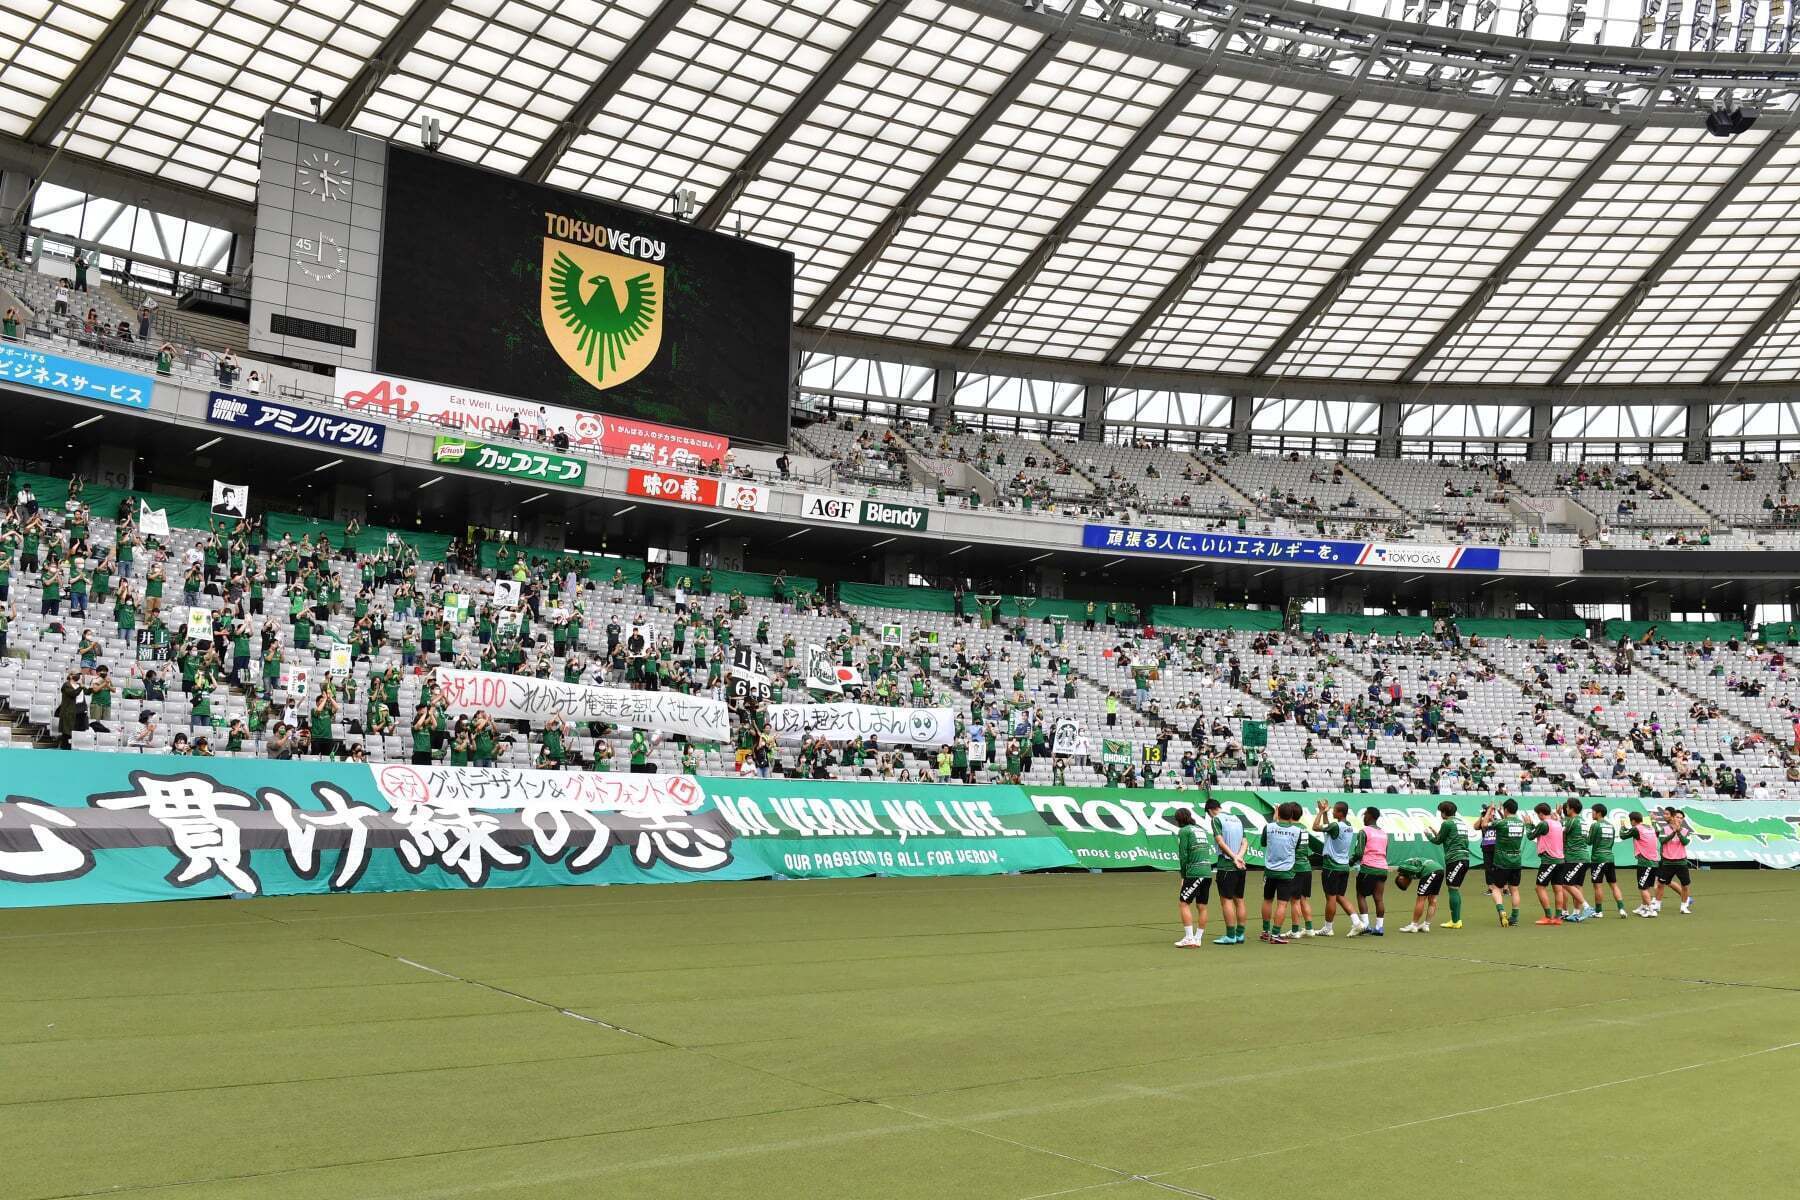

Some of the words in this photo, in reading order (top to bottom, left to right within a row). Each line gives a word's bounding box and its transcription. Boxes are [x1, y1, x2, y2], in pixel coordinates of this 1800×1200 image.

[544, 212, 607, 248] TOKYO
[296, 239, 311, 250] 45
[449, 395, 466, 406] Eat
[496, 403, 516, 414] Live
[254, 406, 378, 447] アミノバイタル
[476, 447, 582, 481] カップスープ
[642, 473, 702, 502] 味の素
[809, 498, 854, 519] AGF
[866, 502, 922, 528] Blendy
[1106, 529, 1339, 561] 頑張る人に、いいエネルギーを。
[1388, 553, 1419, 563] TOKYO
[1422, 554, 1441, 565] GAS
[441, 674, 507, 708] 祝100
[735, 681, 747, 696] 6
[761, 684, 771, 698] 9
[1145, 747, 1161, 761] 13
[784, 853, 812, 870] OUR
[897, 851, 925, 867] ALL
[927, 851, 953, 866] FOR
[1077, 848, 1111, 858] most
